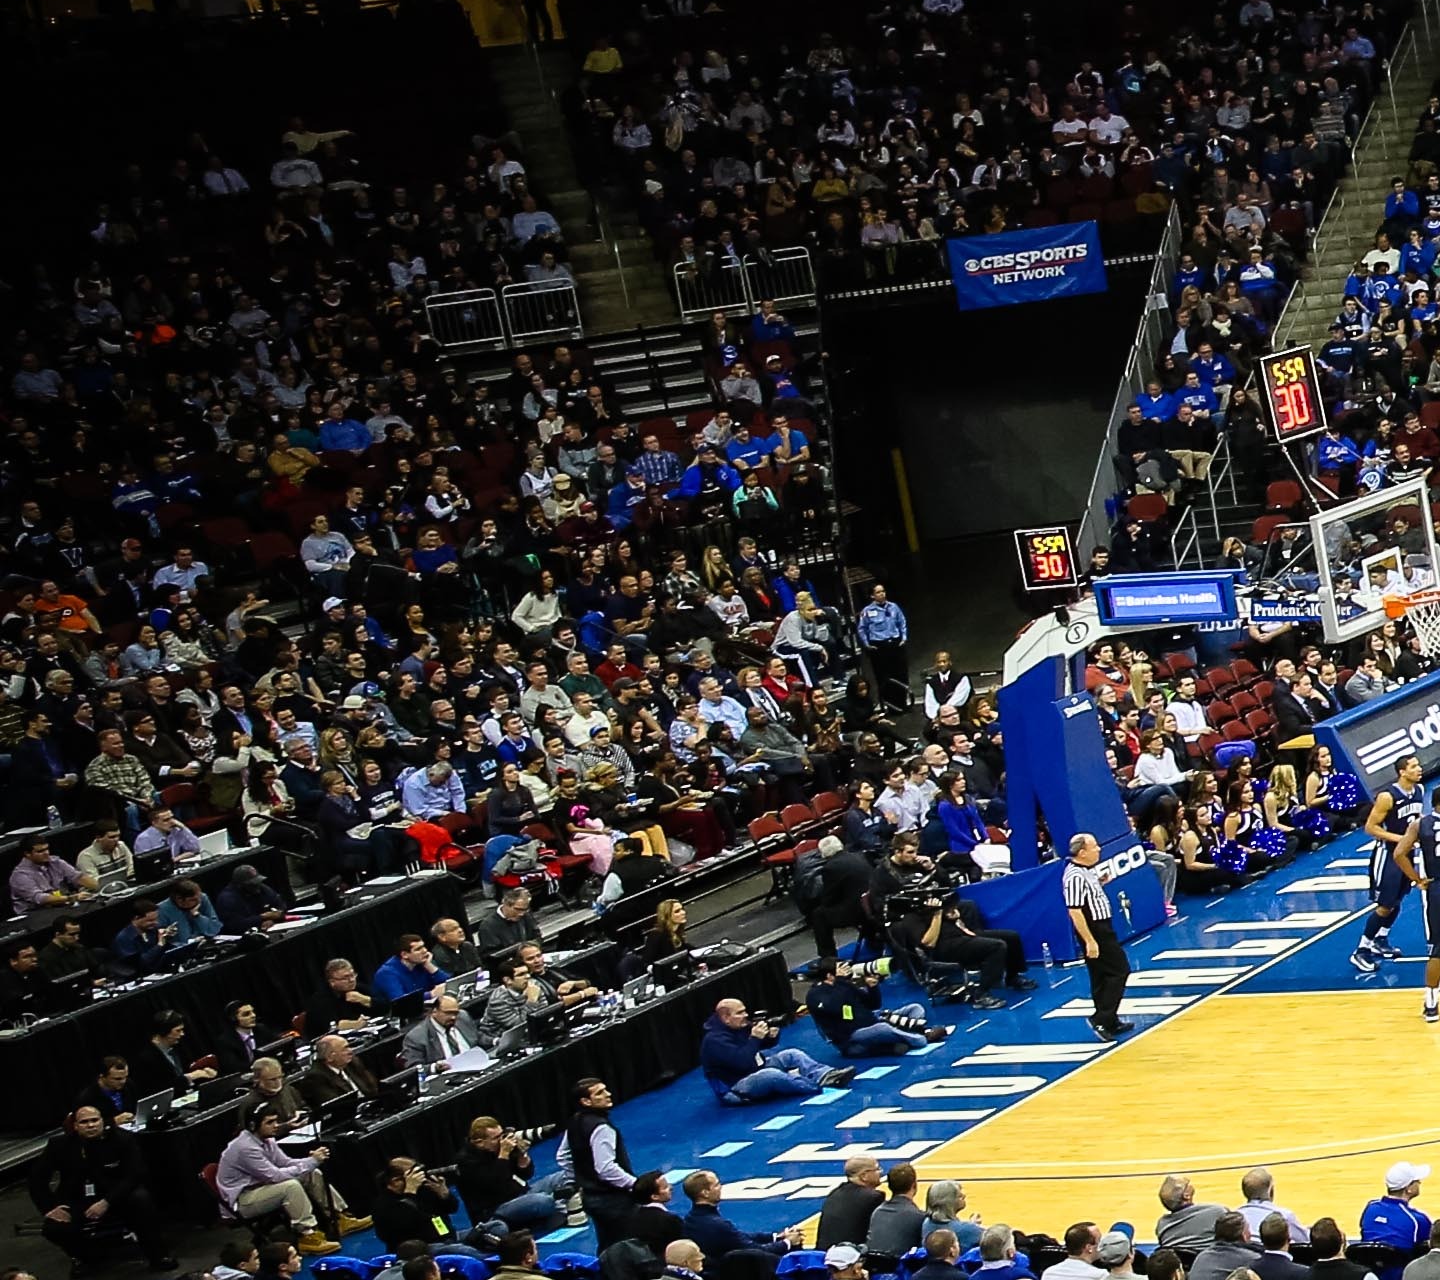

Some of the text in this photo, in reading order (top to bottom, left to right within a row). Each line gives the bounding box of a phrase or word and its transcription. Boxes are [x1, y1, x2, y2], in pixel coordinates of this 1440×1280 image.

[979, 243, 1088, 270] CBS SPORTS
[993, 265, 1066, 285] NETWORK
[1272, 357, 1306, 387] 5:59
[1274, 382, 1311, 430] 30
[1033, 535, 1066, 555] 5:59
[1038, 555, 1063, 578] 30
[1126, 591, 1217, 607] Barnabas Health
[719, 911, 1352, 1200] SETON HALL
